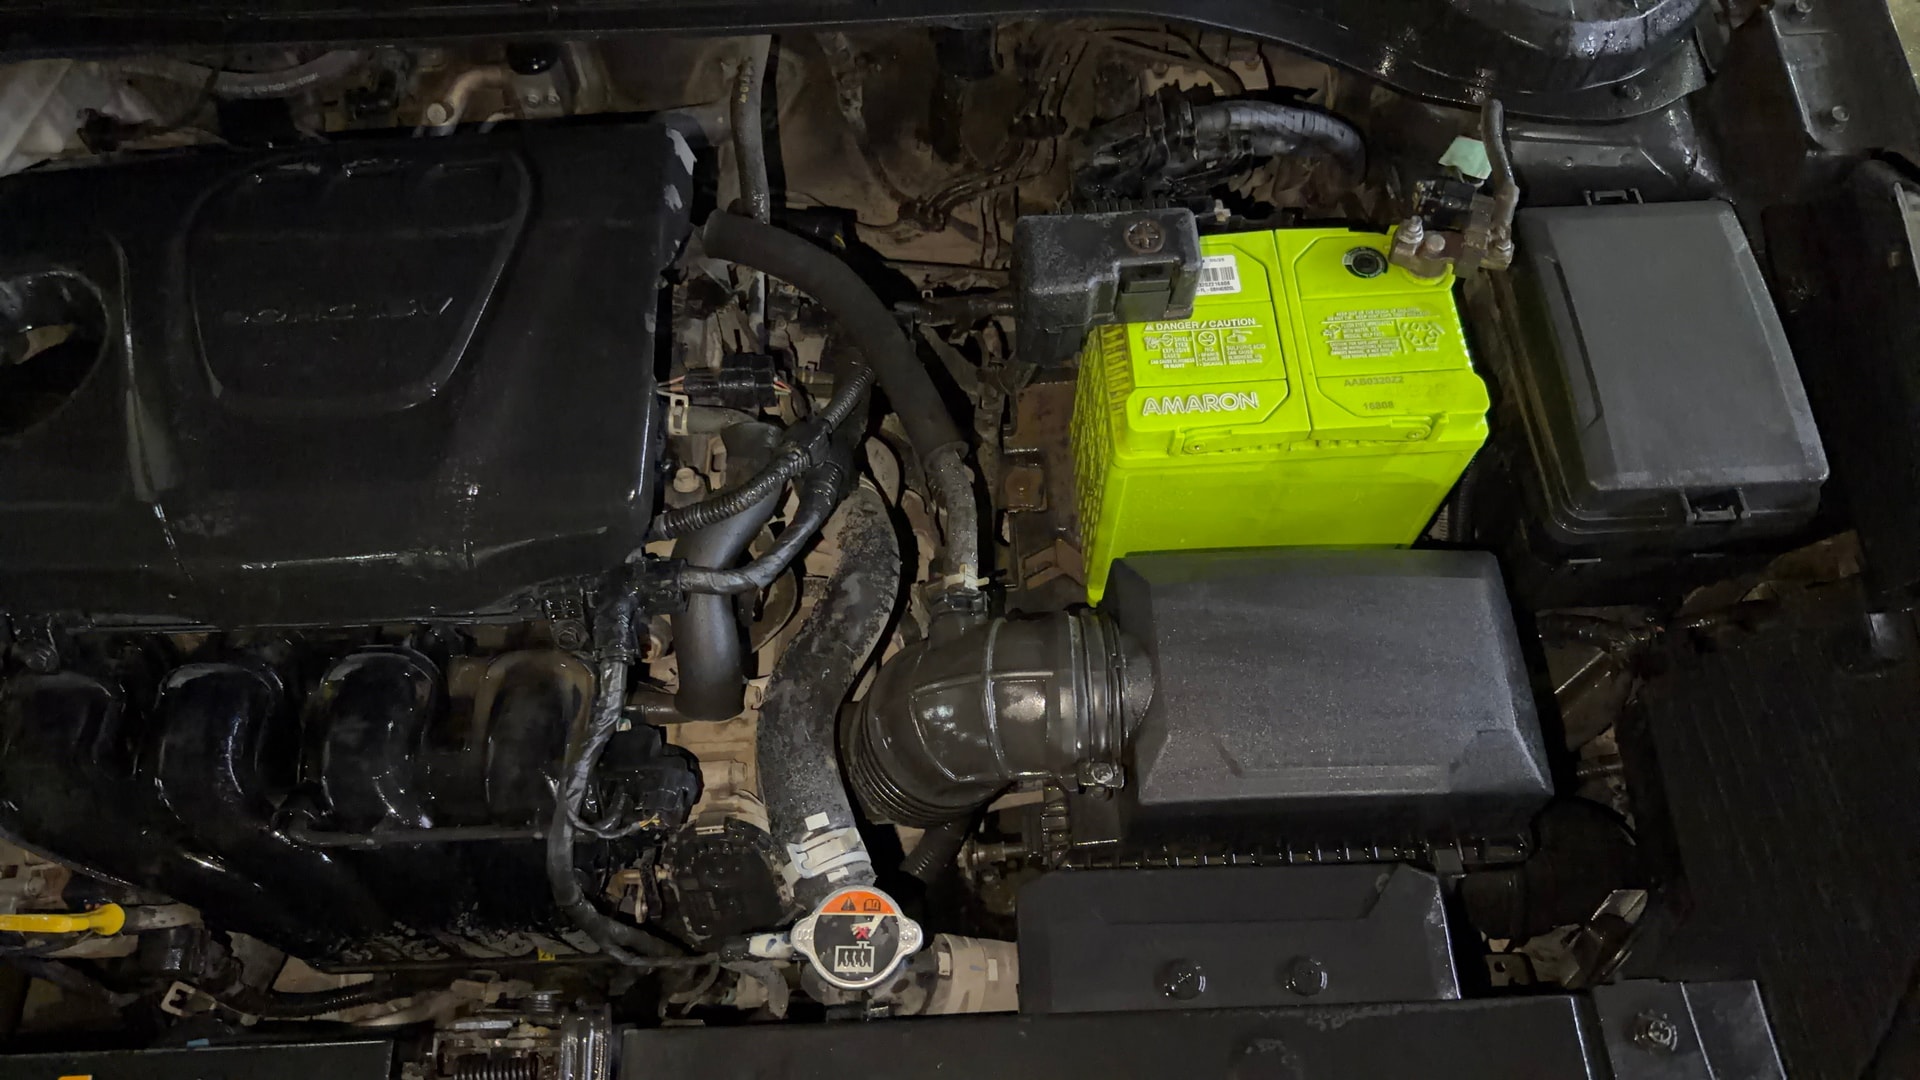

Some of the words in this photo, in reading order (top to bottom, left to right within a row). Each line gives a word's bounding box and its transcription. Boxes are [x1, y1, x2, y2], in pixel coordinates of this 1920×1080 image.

[1156, 321, 1199, 331] DANGER
[1209, 318, 1256, 328] CAUTION
[1143, 391, 1259, 417] AMARON
[1363, 401, 1395, 410] 16808
